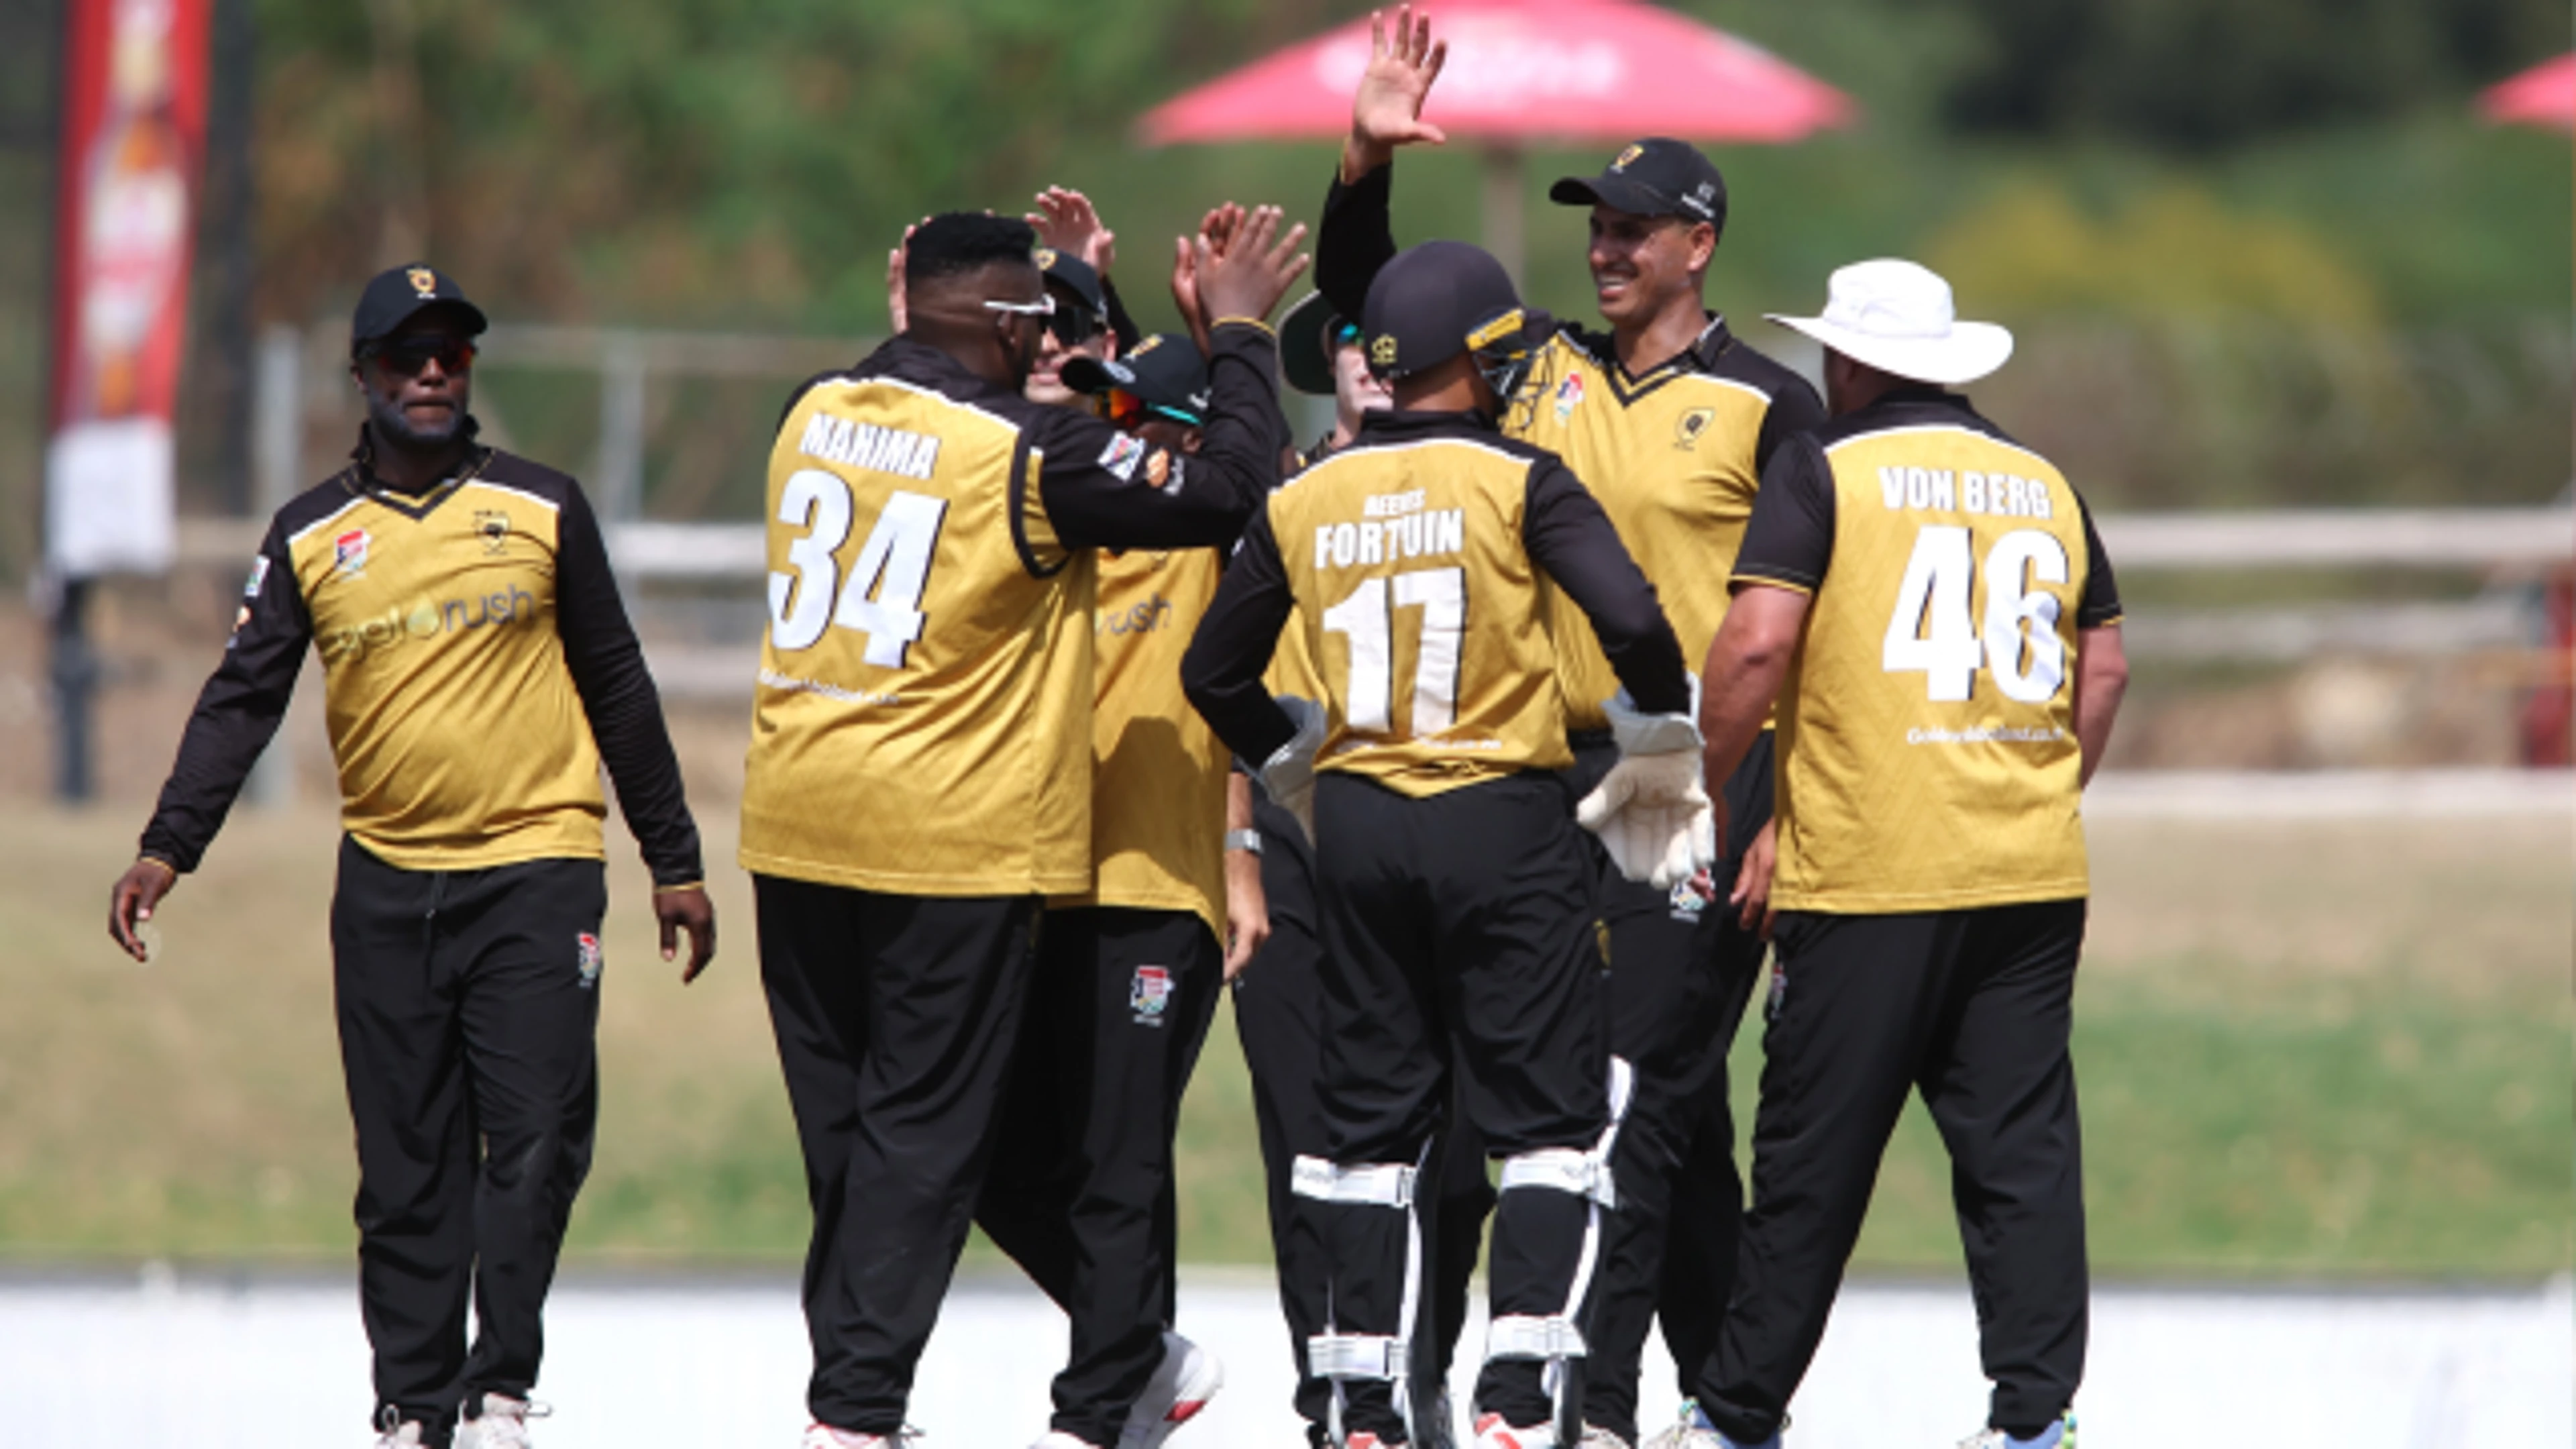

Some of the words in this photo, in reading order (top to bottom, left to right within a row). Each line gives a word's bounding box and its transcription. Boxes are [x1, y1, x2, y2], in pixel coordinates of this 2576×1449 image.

[768, 468, 950, 669] 34
[1315, 508, 1464, 570] FORTUIN
[1878, 466, 1955, 512] VON
[1964, 470, 2053, 519] BERG
[1323, 567, 1468, 739] 17
[1882, 524, 2070, 703] 46
